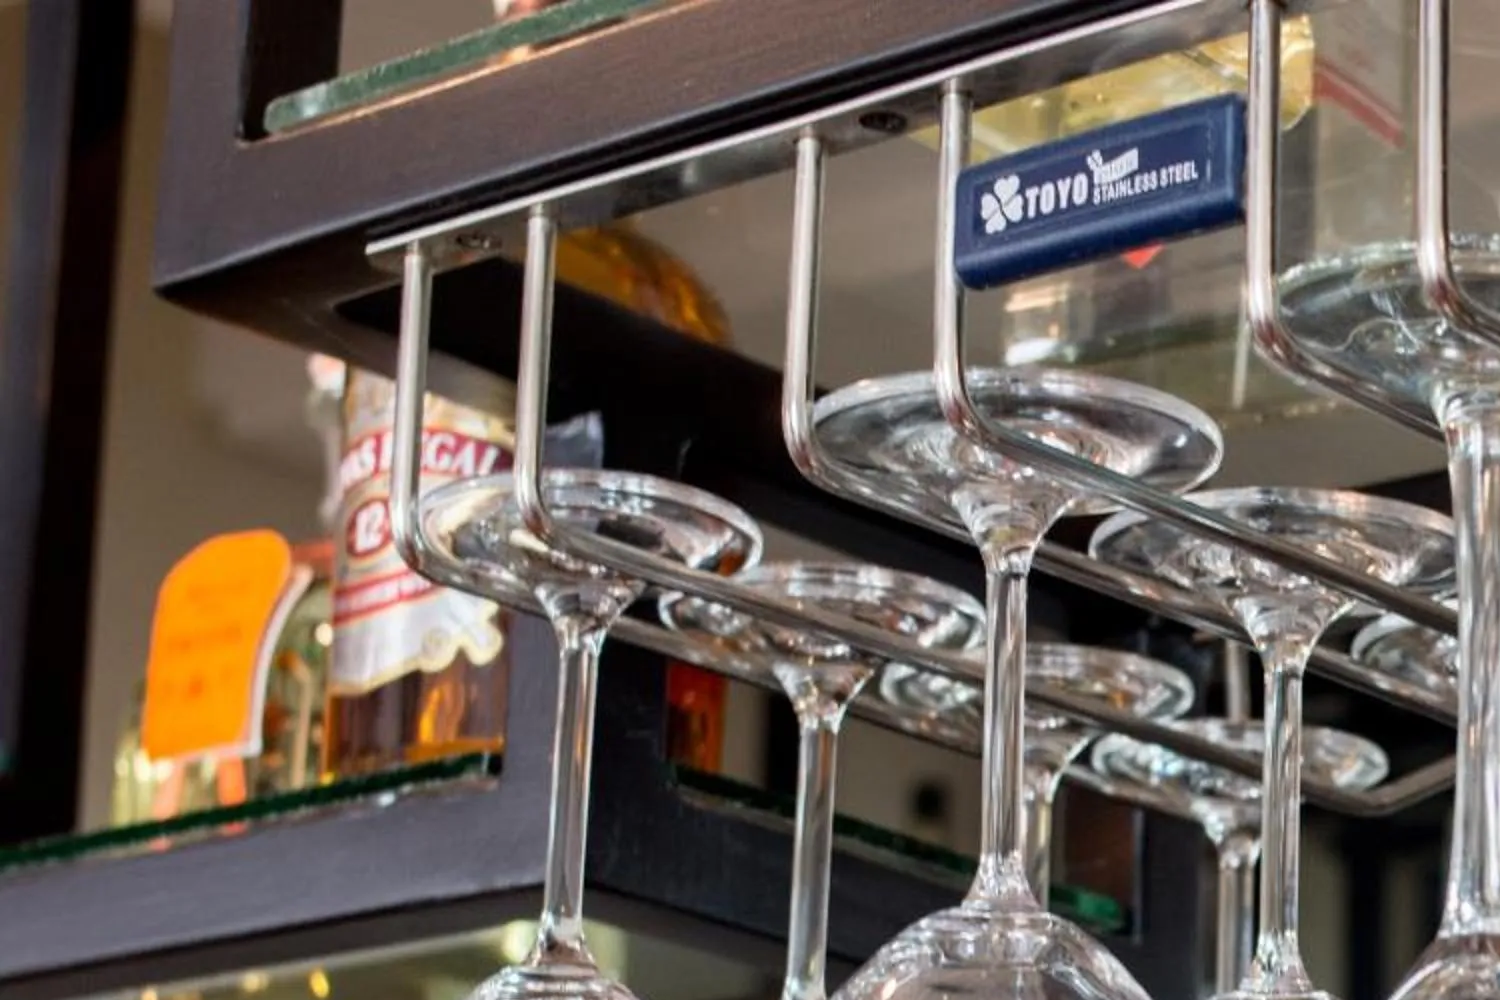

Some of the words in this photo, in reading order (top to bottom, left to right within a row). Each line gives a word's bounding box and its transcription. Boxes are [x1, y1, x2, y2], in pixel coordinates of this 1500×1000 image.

[1025, 172, 1089, 219] TOYO
[1092, 170, 1158, 206] STAINLESS
[1159, 160, 1198, 188] STEEL
